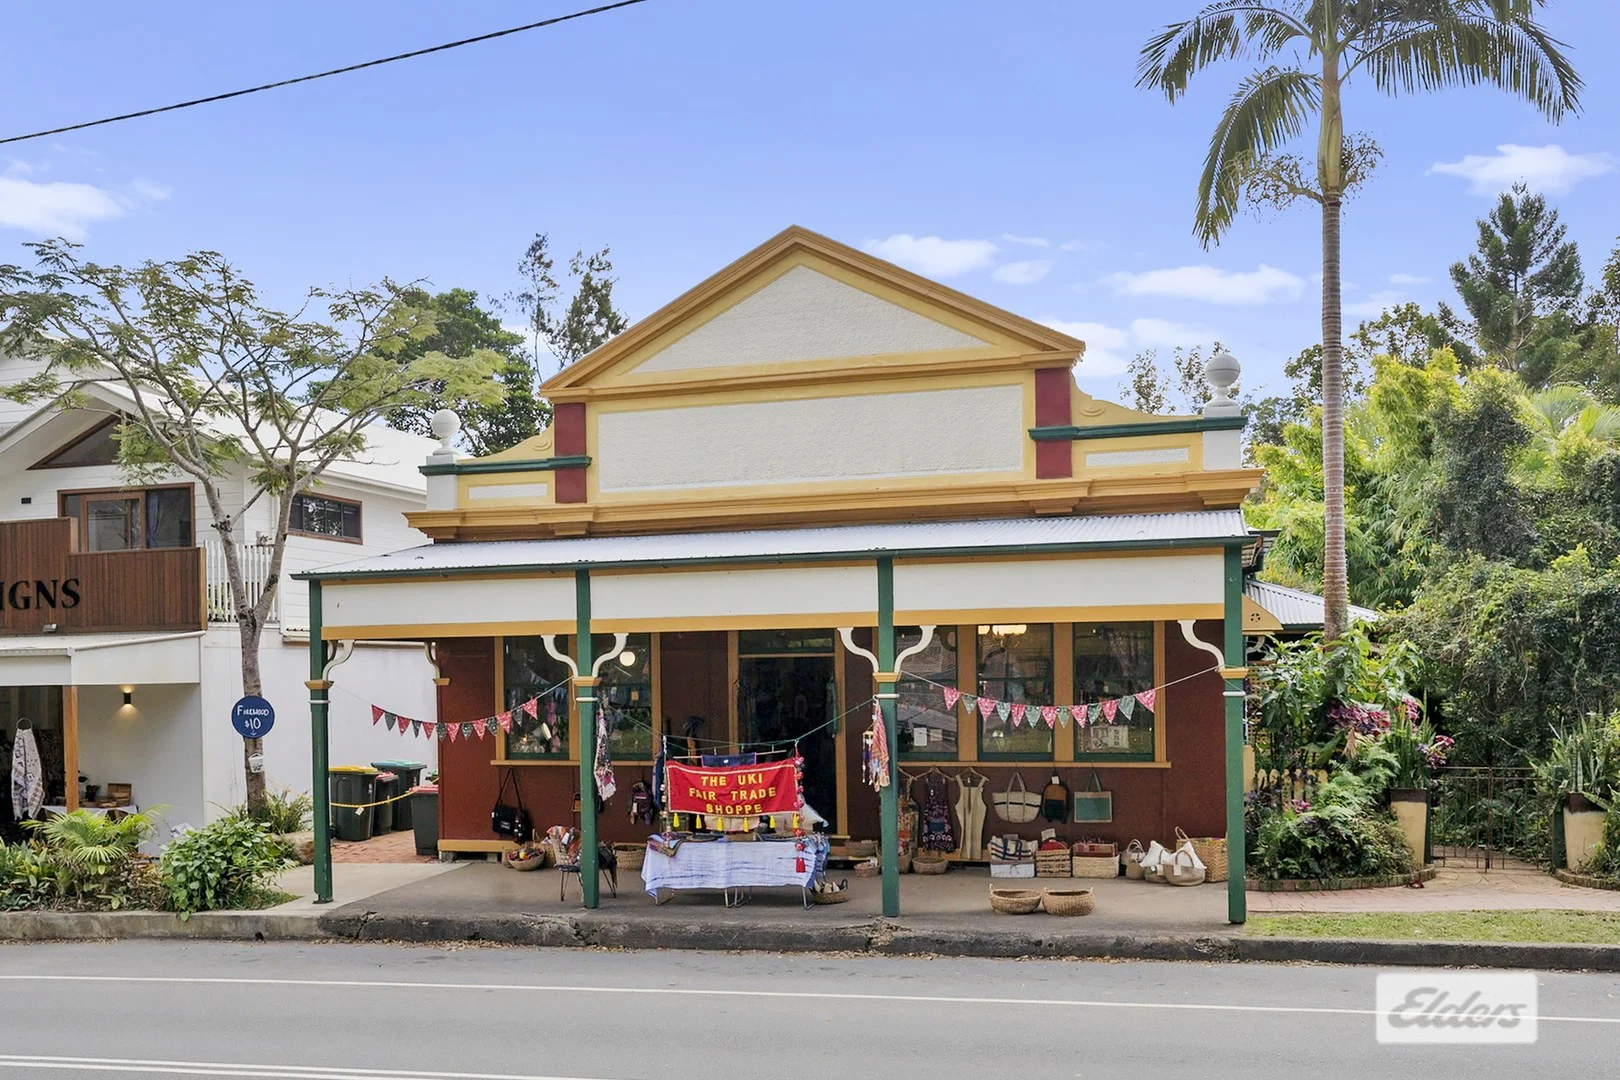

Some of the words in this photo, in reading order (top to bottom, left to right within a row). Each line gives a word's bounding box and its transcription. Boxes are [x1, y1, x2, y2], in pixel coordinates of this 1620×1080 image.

[244, 717, 261, 730] $10
[701, 775, 727, 787] THE
[738, 773, 763, 786] UKI
[689, 787, 716, 801] FAIR
[731, 786, 777, 801] TRADE
[706, 803, 763, 815] SHOPPE
